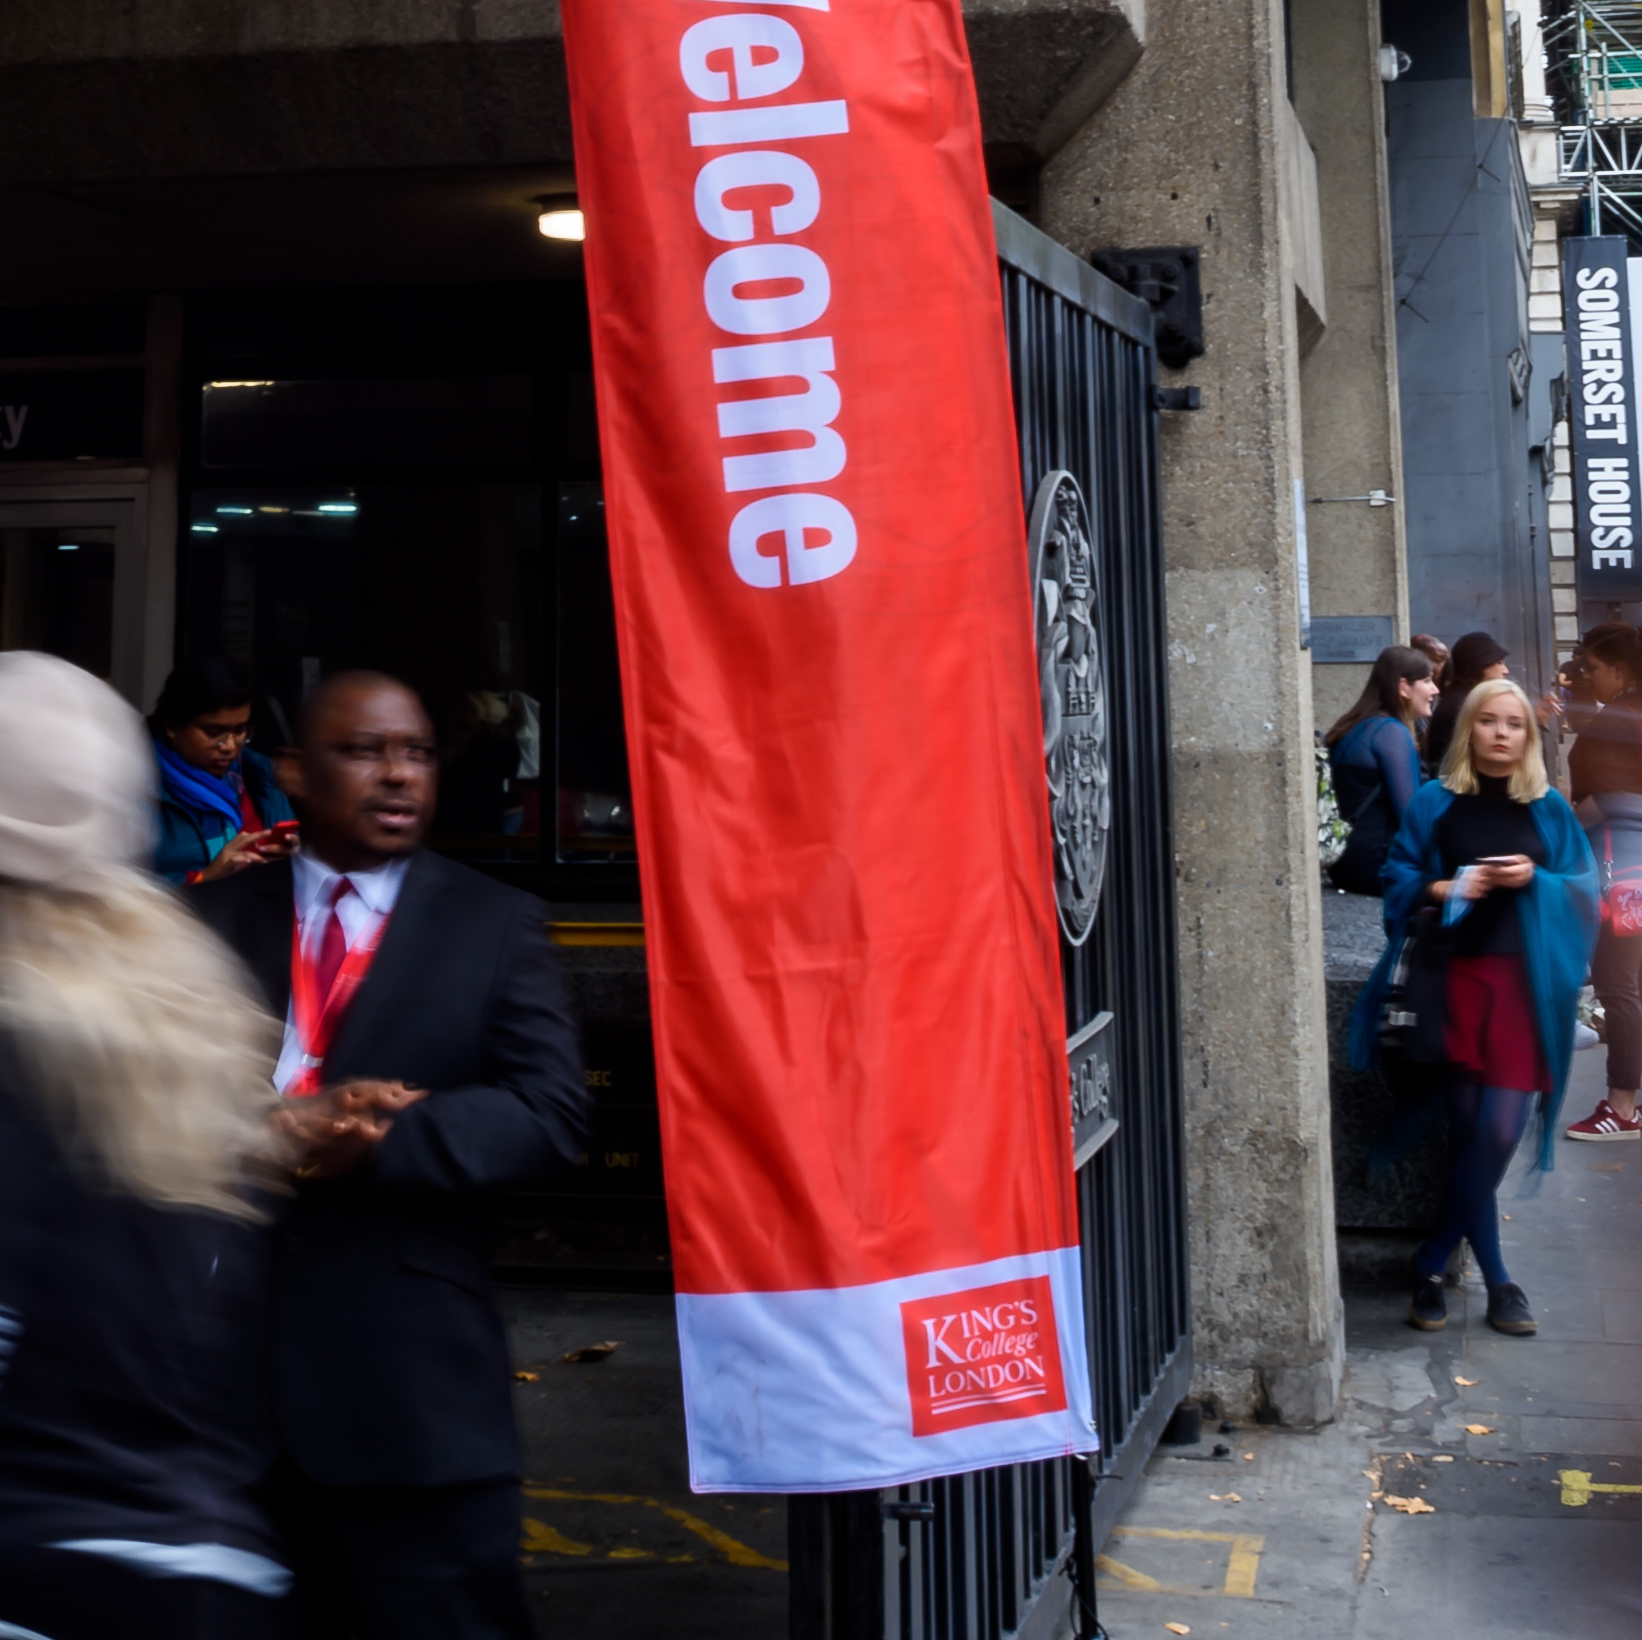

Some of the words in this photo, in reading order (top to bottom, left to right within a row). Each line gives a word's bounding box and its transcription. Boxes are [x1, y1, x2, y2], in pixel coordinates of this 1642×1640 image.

[1575, 266, 1627, 445] SOMERSET
[1587, 456, 1634, 570] HOUSE
[604, 1150, 640, 1169] UNIT
[921, 1299, 1038, 1369] KING'S
[966, 1331, 1039, 1362] College
[928, 1355, 1045, 1398] LONDON
